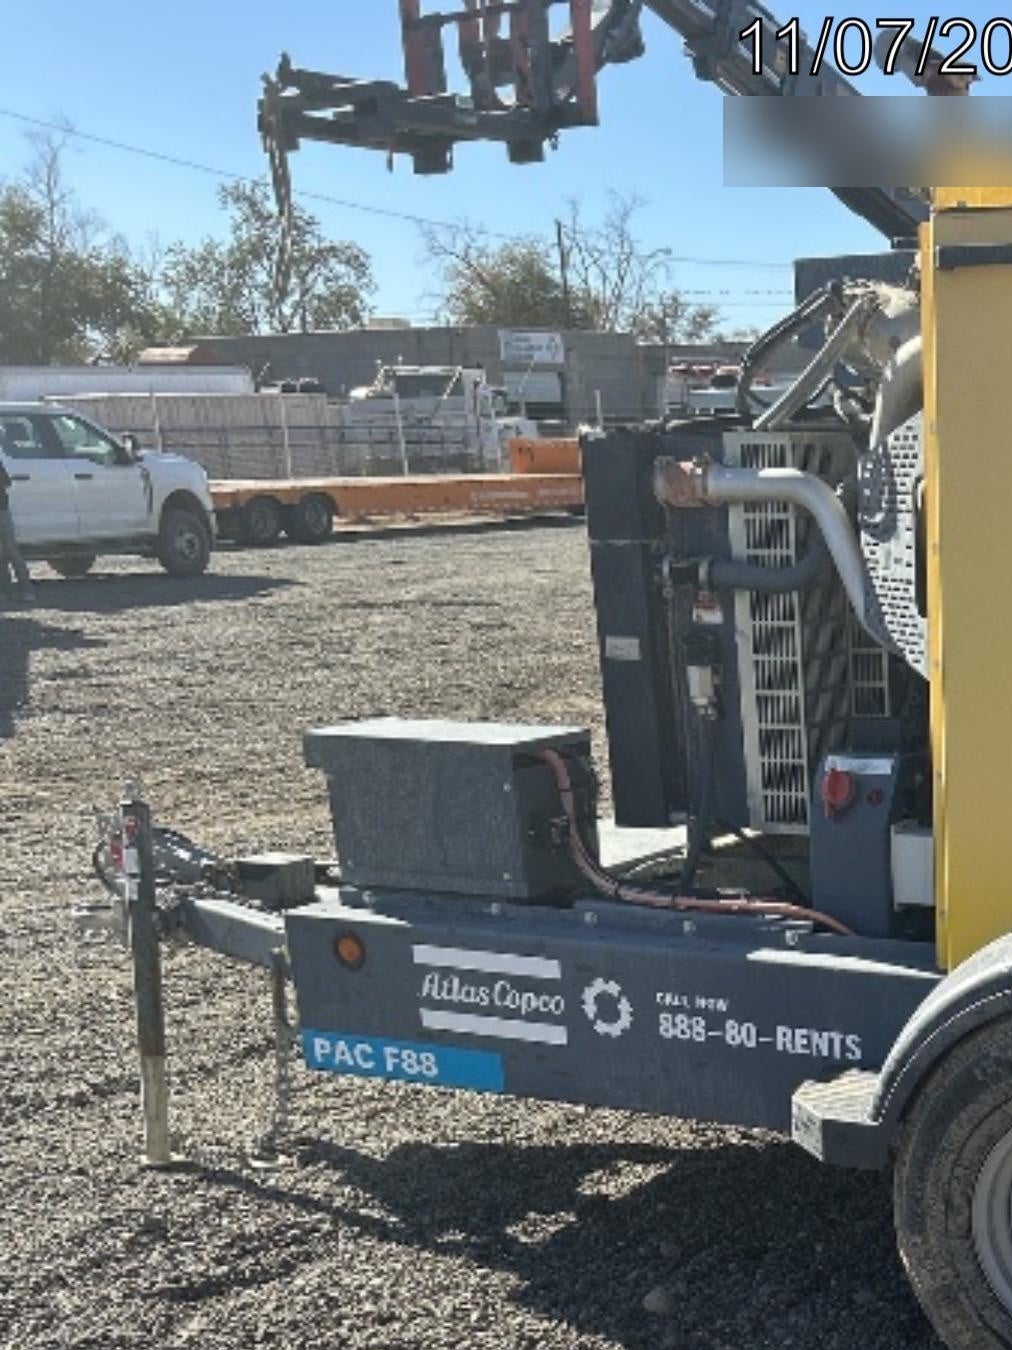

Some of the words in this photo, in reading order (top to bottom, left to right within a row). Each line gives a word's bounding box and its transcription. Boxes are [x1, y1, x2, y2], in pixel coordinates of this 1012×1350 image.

[420, 971, 489, 1006] Atlas
[494, 980, 565, 1015] Copco
[313, 1036, 375, 1069] PAC
[384, 1046, 440, 1077] F88
[659, 1012, 863, 1060] 888-80-RENTS
